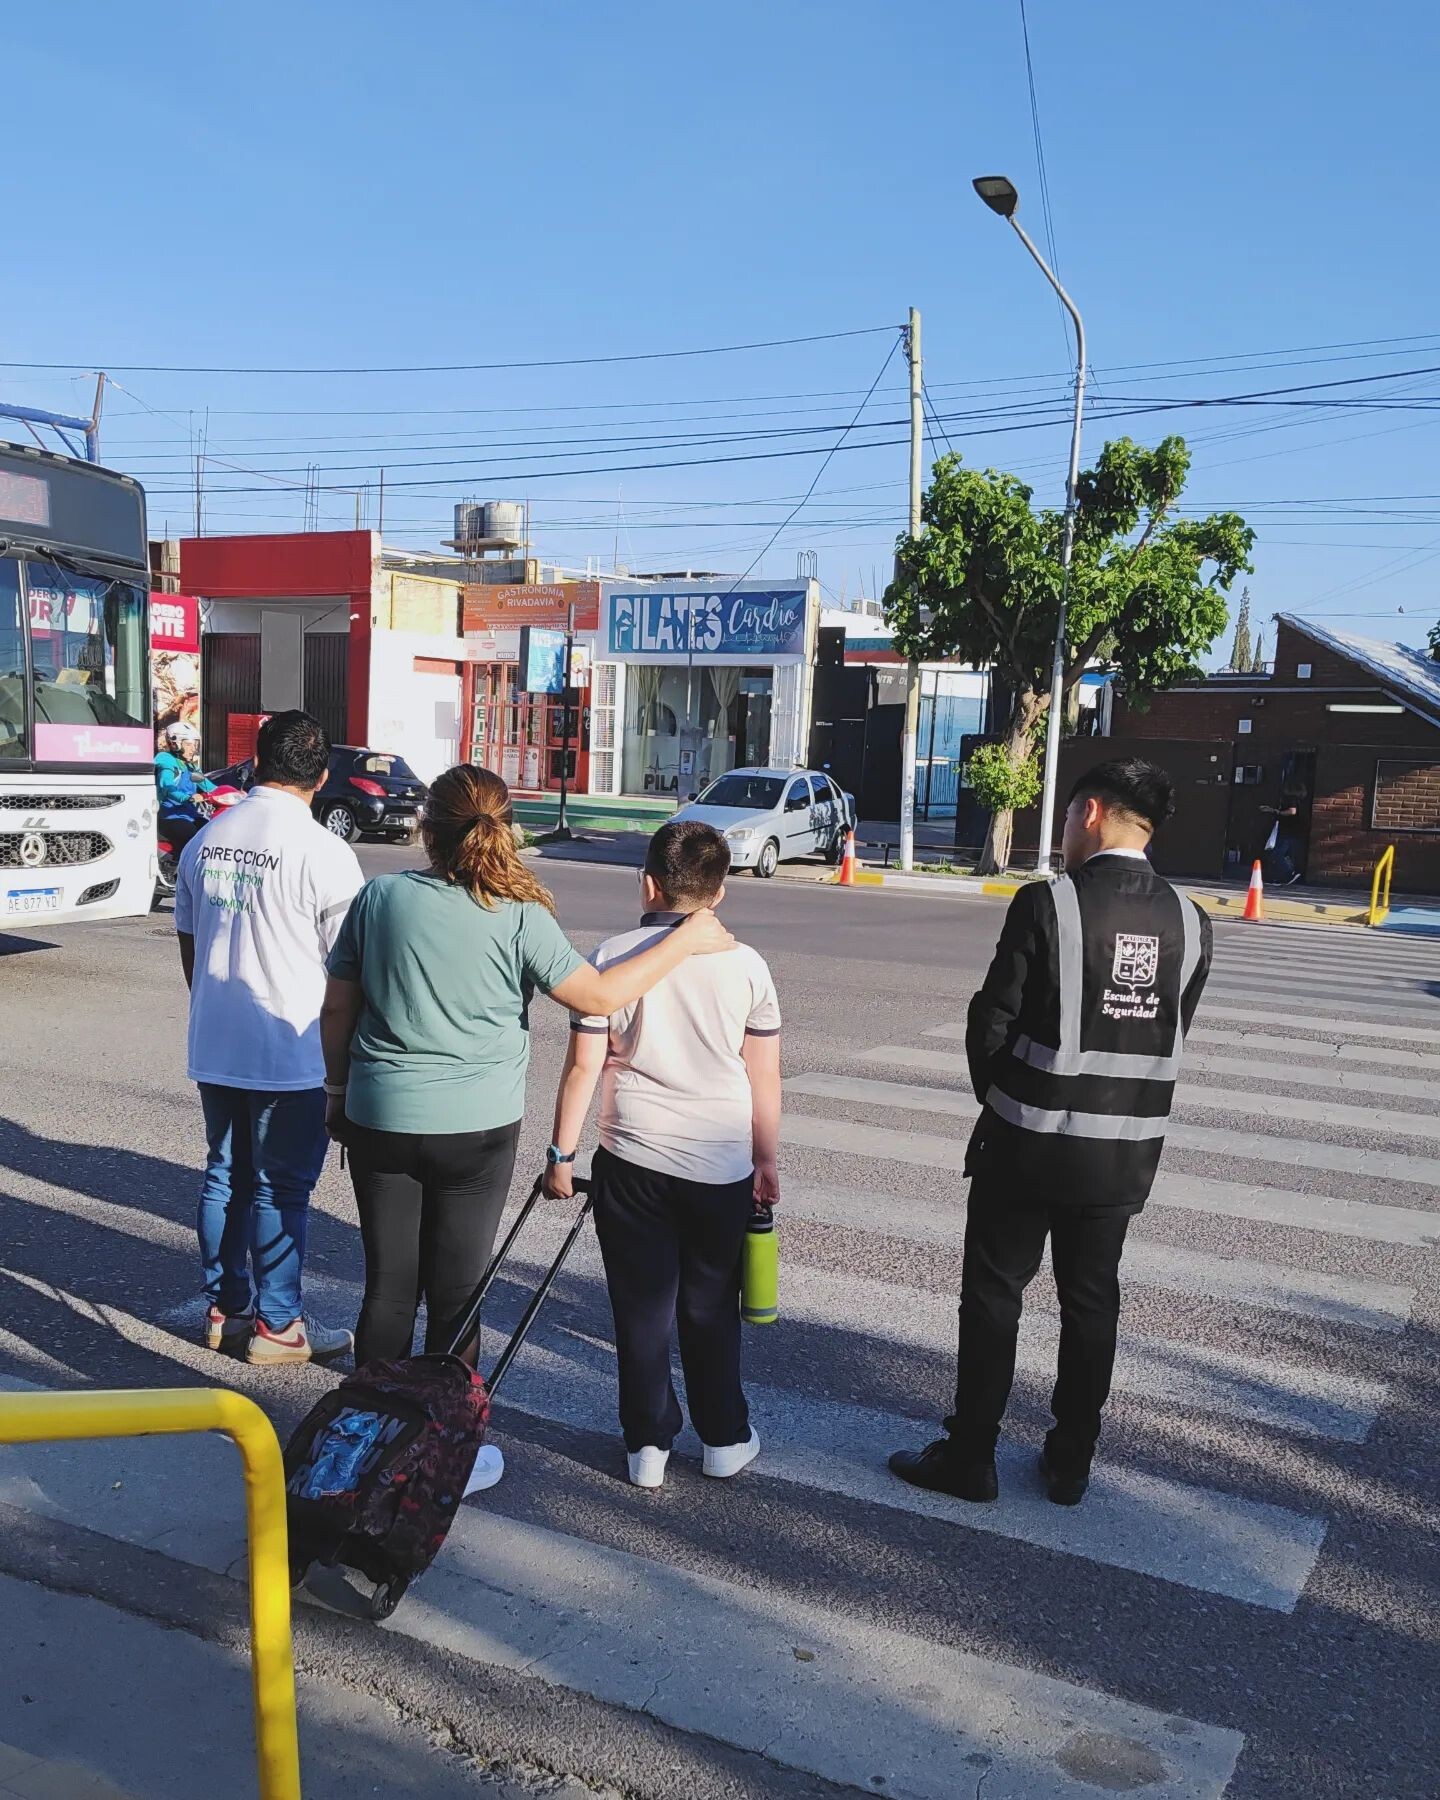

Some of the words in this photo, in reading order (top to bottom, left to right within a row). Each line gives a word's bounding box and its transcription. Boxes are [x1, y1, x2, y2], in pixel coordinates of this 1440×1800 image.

[497, 585, 565, 600] GASTRONOMIA
[507, 598, 555, 608] RIVADAVIA
[615, 596, 723, 650] PILATES
[727, 598, 799, 635] Cardio
[201, 846, 279, 871] DIRECCIÓN
[1103, 989, 1142, 1004] Escuela
[1145, 992, 1160, 1005] de
[1102, 1003, 1158, 1020] Seguridad
